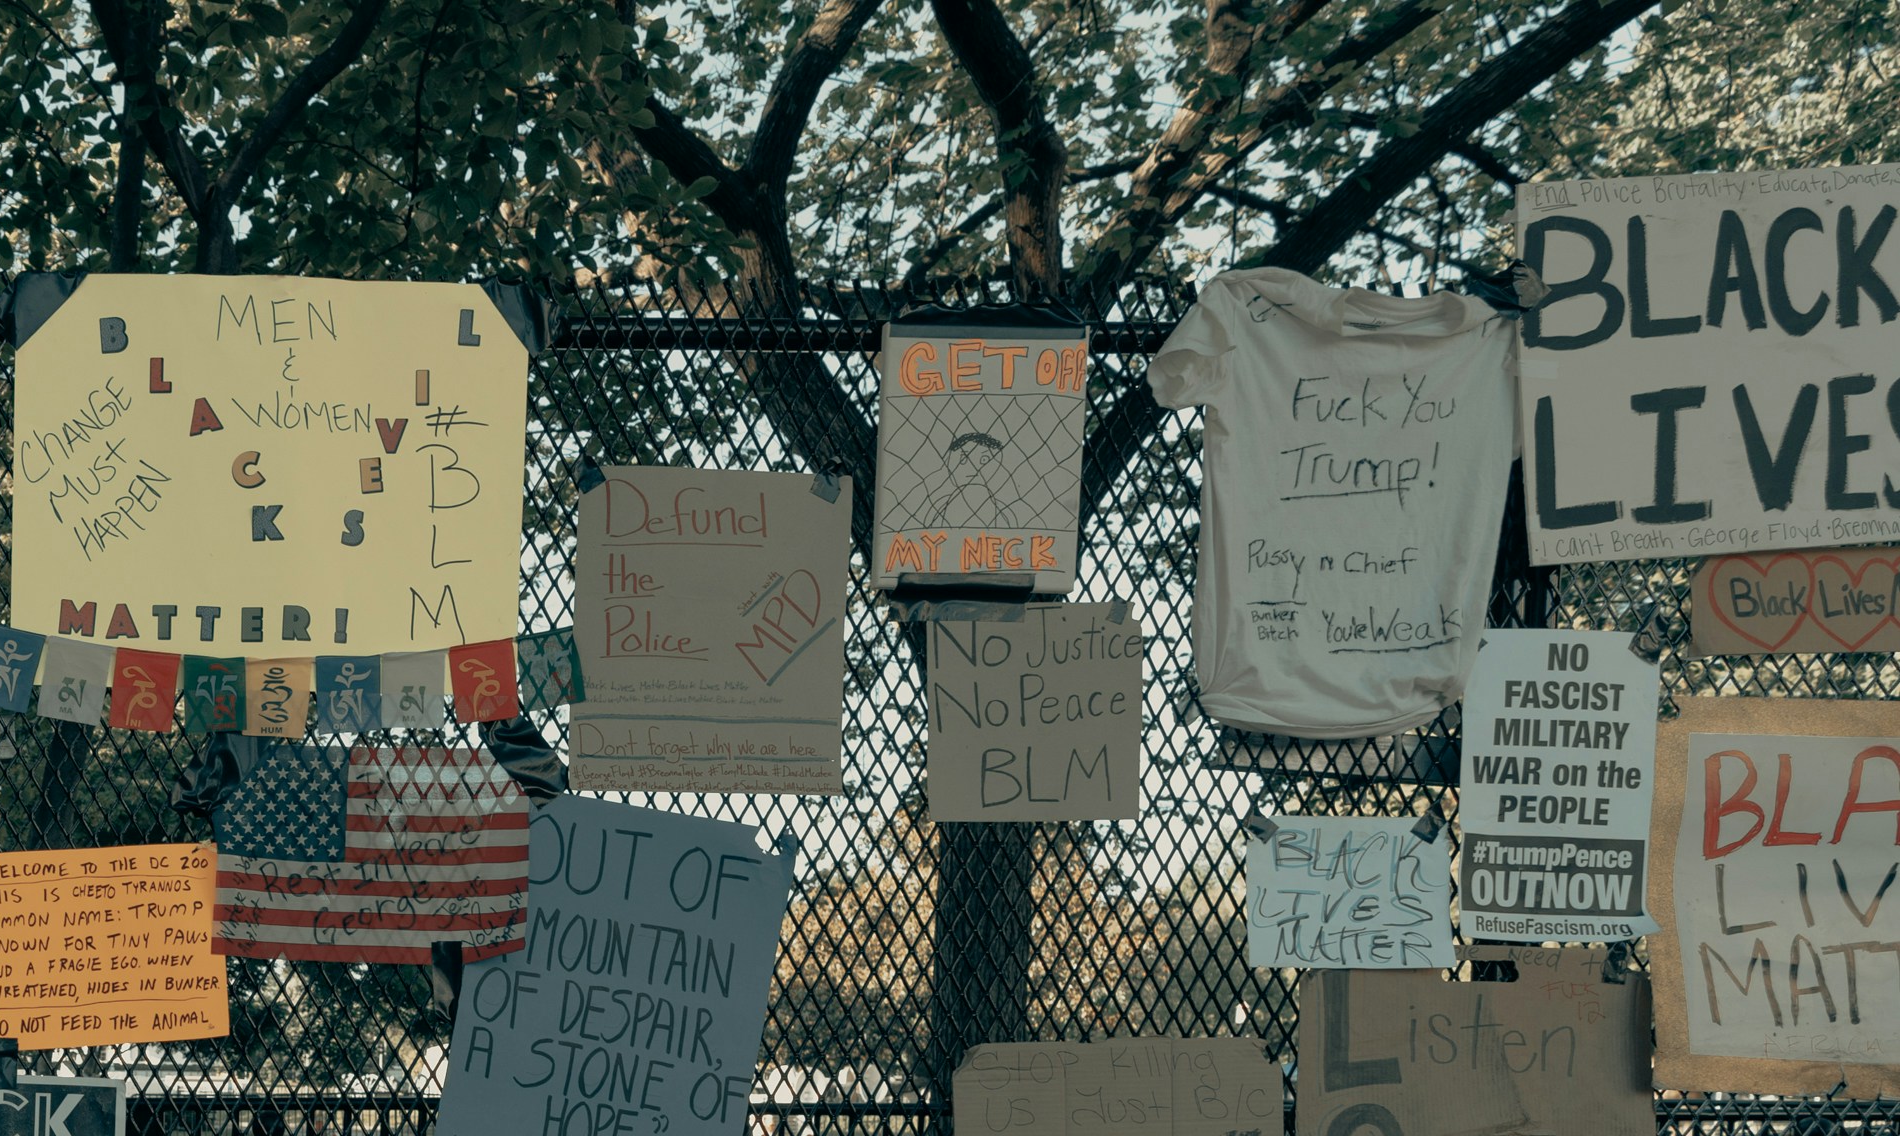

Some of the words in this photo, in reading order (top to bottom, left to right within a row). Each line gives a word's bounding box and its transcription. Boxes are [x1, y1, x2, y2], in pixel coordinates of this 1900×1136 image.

[1580, 182, 1641, 204] Police
[1654, 182, 1746, 205] Brutality
[1522, 204, 1900, 351] BLACK
[216, 294, 336, 345] MEN
[901, 341, 1030, 395] GET
[232, 392, 371, 434] WOMEN
[1292, 376, 1388, 428] Fuck
[1401, 374, 1456, 429] You
[74, 460, 172, 562] HAPPEN
[604, 479, 768, 538] Defund
[1688, 527, 1759, 547] George
[1768, 520, 1821, 541] Floyd
[885, 536, 948, 572] MY
[960, 535, 1058, 571] NECK
[1344, 547, 1418, 575] Chief
[603, 554, 664, 595] the
[1730, 578, 1807, 618] Black
[1819, 580, 1885, 618] Lives
[605, 605, 709, 656] Police
[1028, 606, 1142, 669] Justice
[1547, 643, 1589, 671] NO
[935, 681, 1009, 733] No
[1021, 674, 1126, 726] Peace
[1504, 682, 1625, 711] FASCIST
[260, 726, 283, 735] HUM
[578, 723, 637, 756] Don't
[647, 726, 699, 763] forget
[1493, 719, 1630, 750] MILITARY
[980, 744, 1111, 808] BLM
[1472, 756, 1542, 786] WAR
[1553, 764, 1588, 787] on
[1596, 760, 1641, 789] the
[1498, 795, 1609, 825] PEOPLE
[81, 862, 97, 874] TO
[110, 858, 137, 872] THE
[150, 856, 169, 869] DC
[1473, 842, 1632, 869] #TrumpPence
[73, 885, 115, 899] CHEETO
[122, 880, 191, 895] TYRANNOS
[670, 847, 762, 920] OF
[1472, 873, 1631, 910] OUTNOW
[128, 901, 203, 919] TRUMP
[1476, 916, 1633, 936] RefuseFascism.org
[65, 936, 94, 950] FOR
[107, 933, 149, 948] TINY
[526, 907, 734, 998] MOUNTAIN
[88, 981, 128, 995] HIDES
[20, 1015, 50, 1033] NOT
[61, 1015, 101, 1031] FEED
[110, 1014, 139, 1029] THE
[474, 968, 541, 1029] OF
[559, 980, 722, 1073] DESPAIR,
[514, 1038, 675, 1111] STONE
[690, 1073, 752, 1124] OF
